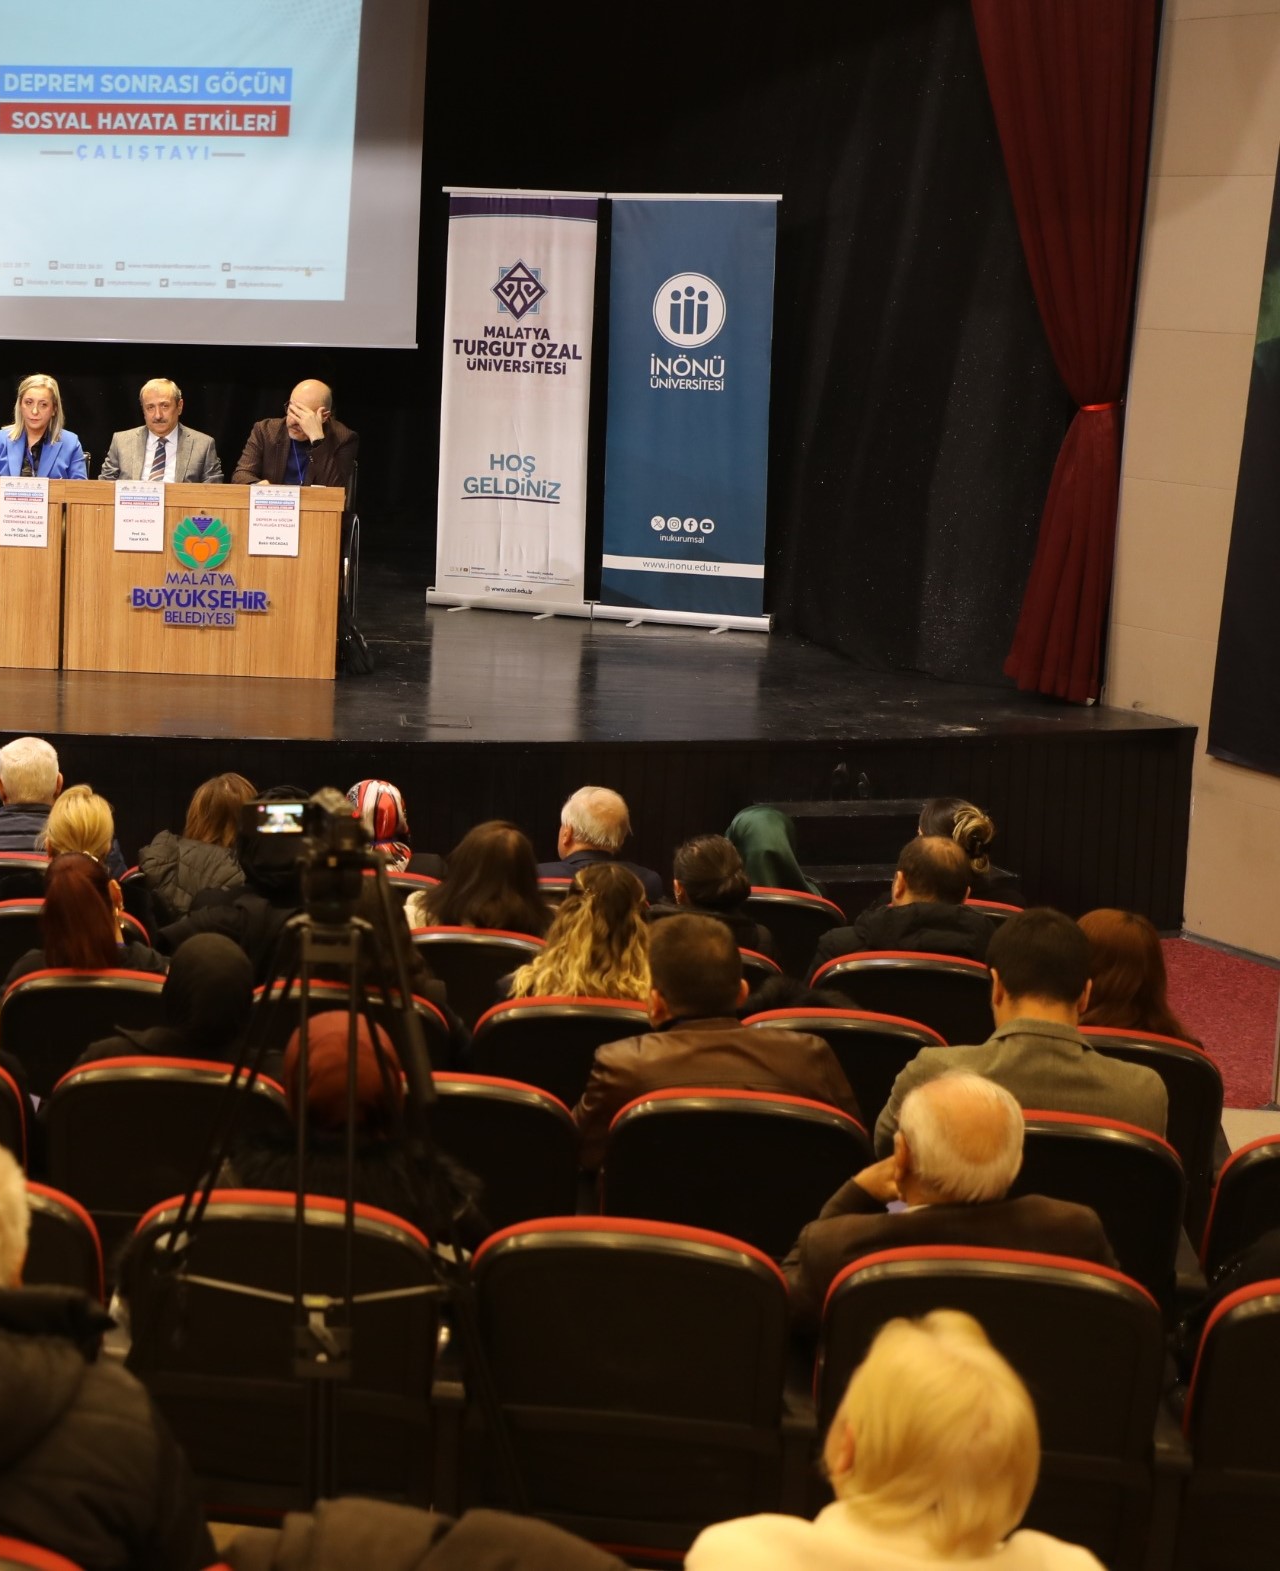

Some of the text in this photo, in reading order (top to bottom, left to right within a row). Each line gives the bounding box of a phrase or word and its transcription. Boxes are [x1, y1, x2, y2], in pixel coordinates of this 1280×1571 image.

[4, 71, 286, 97] DEPREM SONRASI GÖÇÜN
[11, 110, 277, 132] SOSYAL HAYATA ETKİLERİ
[76, 144, 210, 162] ÇALIŞTAYI
[484, 326, 550, 340] MALATYA
[452, 339, 583, 360] TURGUT ÖZAL
[466, 358, 566, 375] ÜNİVERSİTESİ
[650, 353, 725, 378] İNÖNÜ
[650, 375, 725, 391] ÜNİVERSİTESİ
[490, 453, 536, 478] HOŞ
[463, 476, 562, 500] GELDİNİZ
[659, 533, 705, 544] inukurumsal
[642, 561, 721, 573] www.inonu.edu.tr
[166, 572, 235, 586] MALATYA
[132, 588, 267, 611] BÜYÜKŞEHİR
[164, 611, 234, 625] BELEDİYESİ
